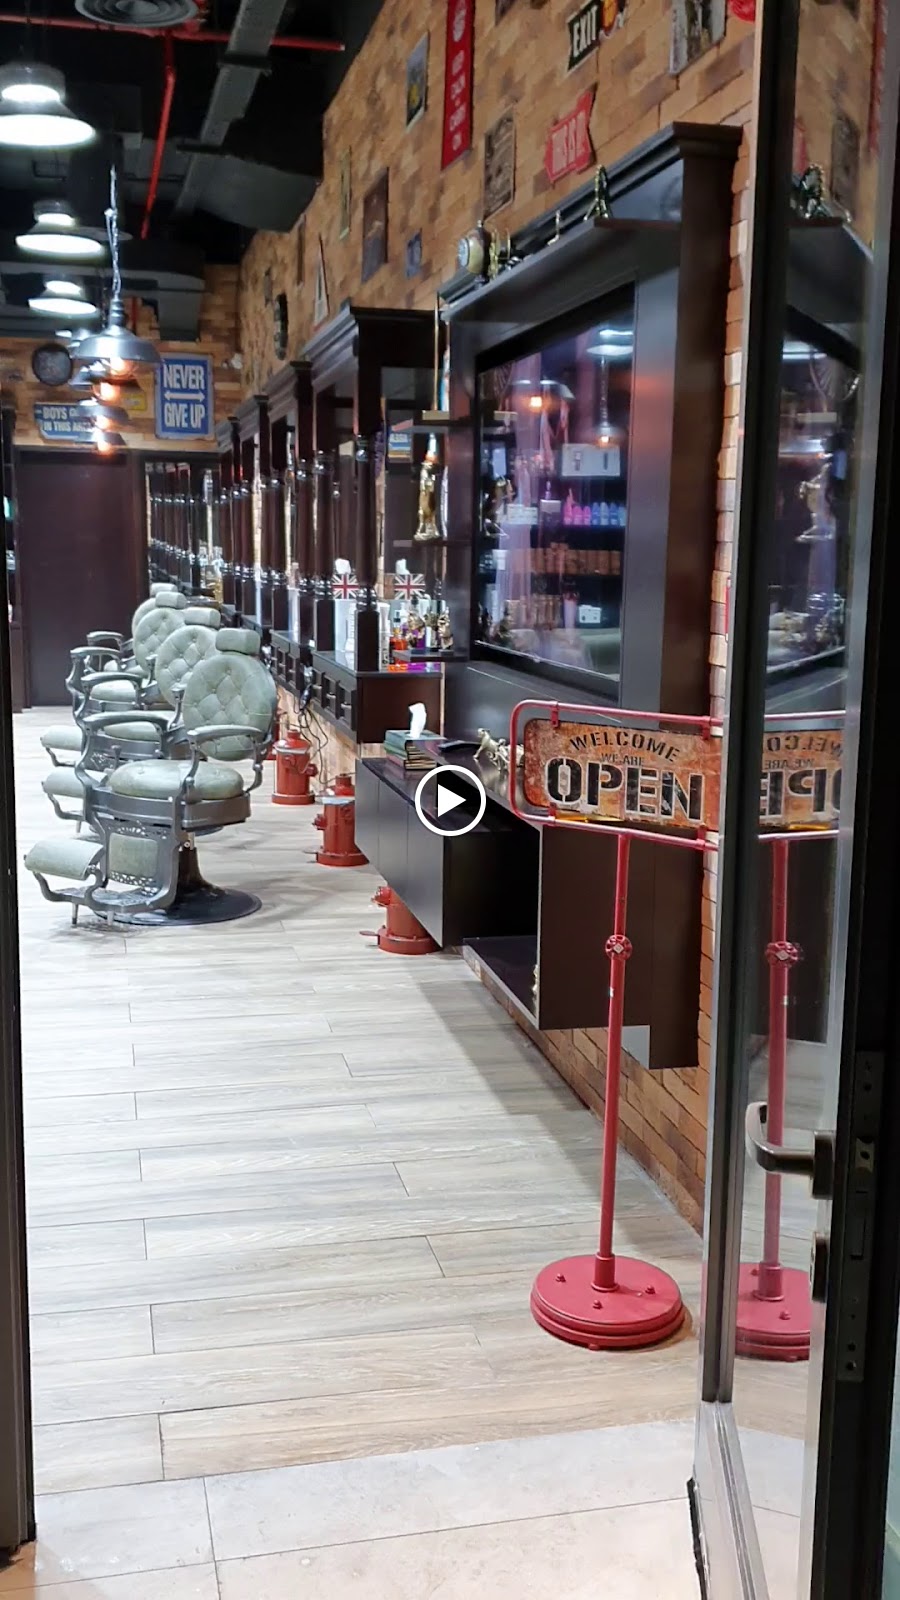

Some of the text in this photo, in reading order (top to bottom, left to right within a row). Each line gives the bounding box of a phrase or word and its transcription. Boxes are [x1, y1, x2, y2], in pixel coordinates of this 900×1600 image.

[573, 5, 599, 58] EXIT
[163, 364, 205, 390] NEVER
[54, 421, 71, 432] THIS
[164, 402, 206, 429] GIVE UP
[569, 731, 681, 763] WELCOME
[600, 753, 645, 767] WE ARE
[546, 757, 705, 822] OPEN
